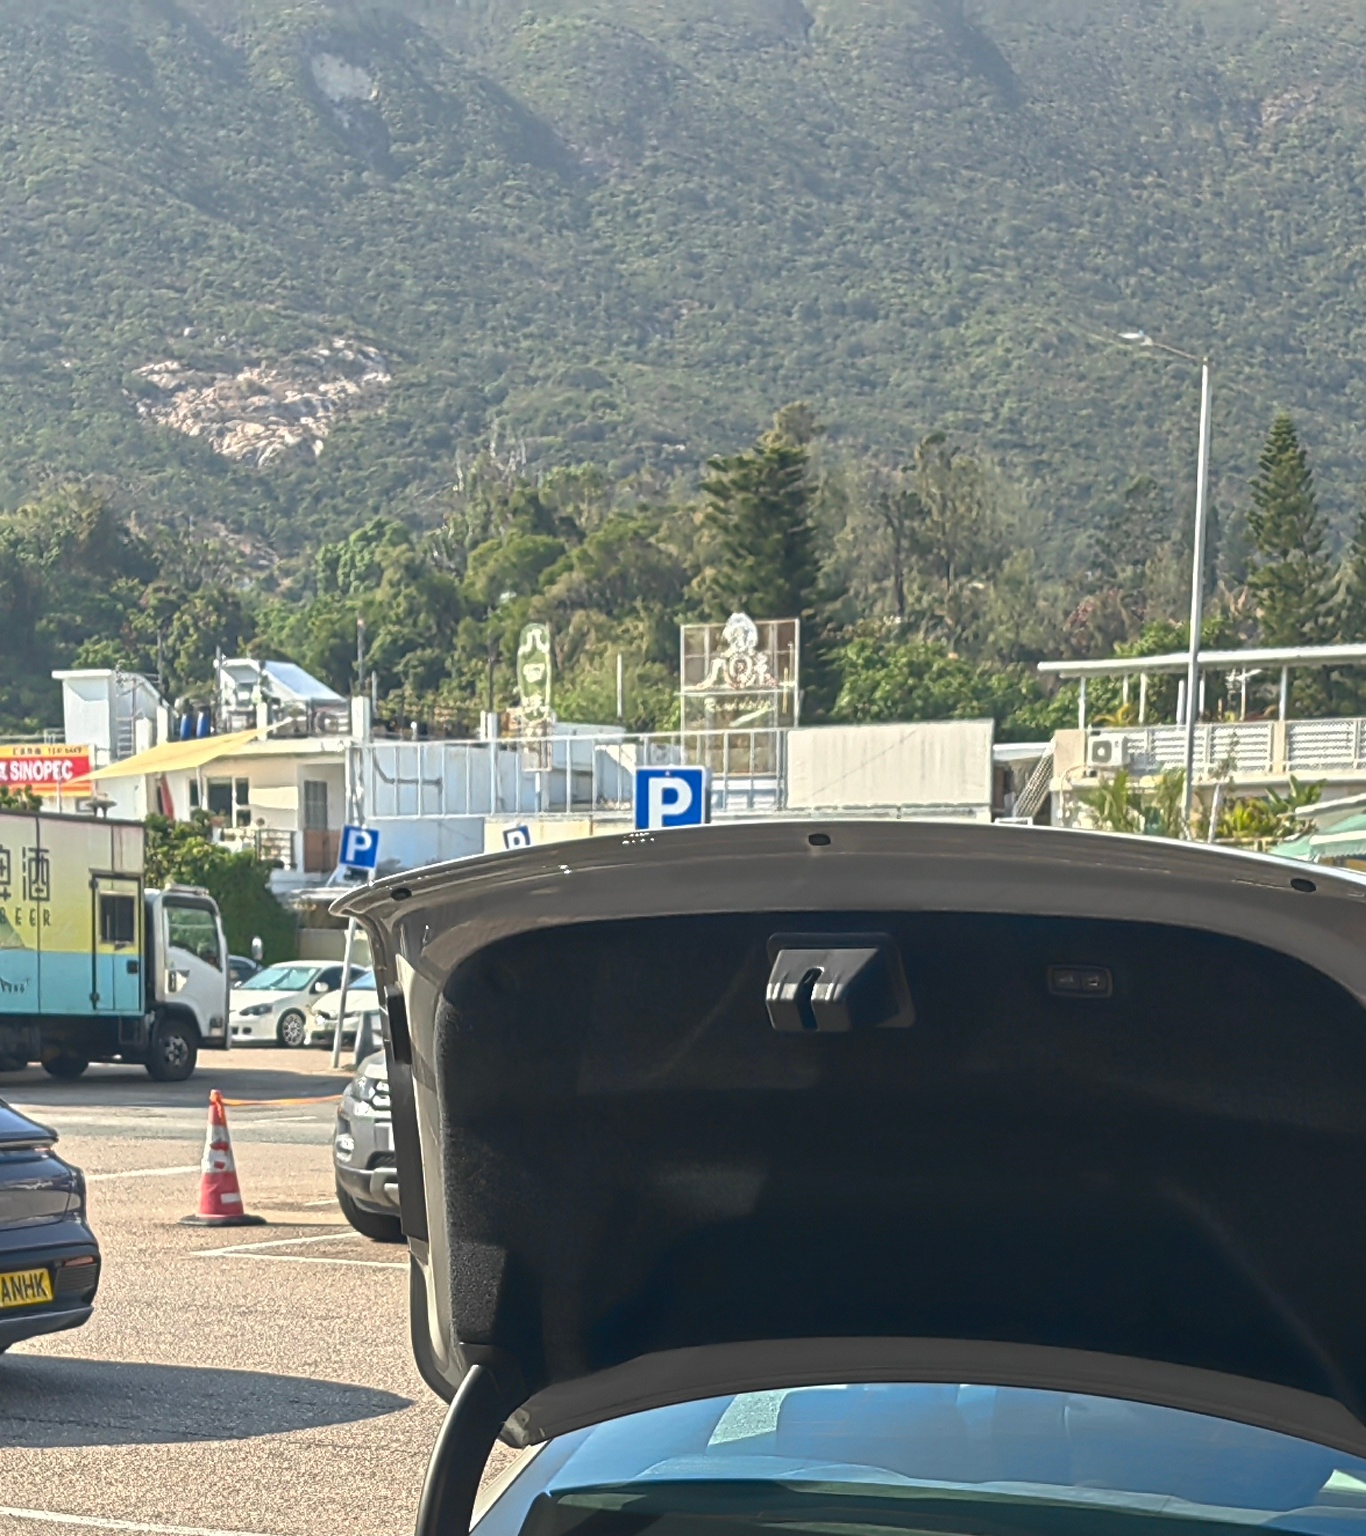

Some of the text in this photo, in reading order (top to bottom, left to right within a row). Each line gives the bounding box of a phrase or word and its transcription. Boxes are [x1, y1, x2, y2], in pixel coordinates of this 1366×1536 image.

[9, 760, 74, 782] SINOPEC
[648, 777, 693, 829] P
[345, 828, 373, 862] P
[0, 906, 52, 927] BEER
